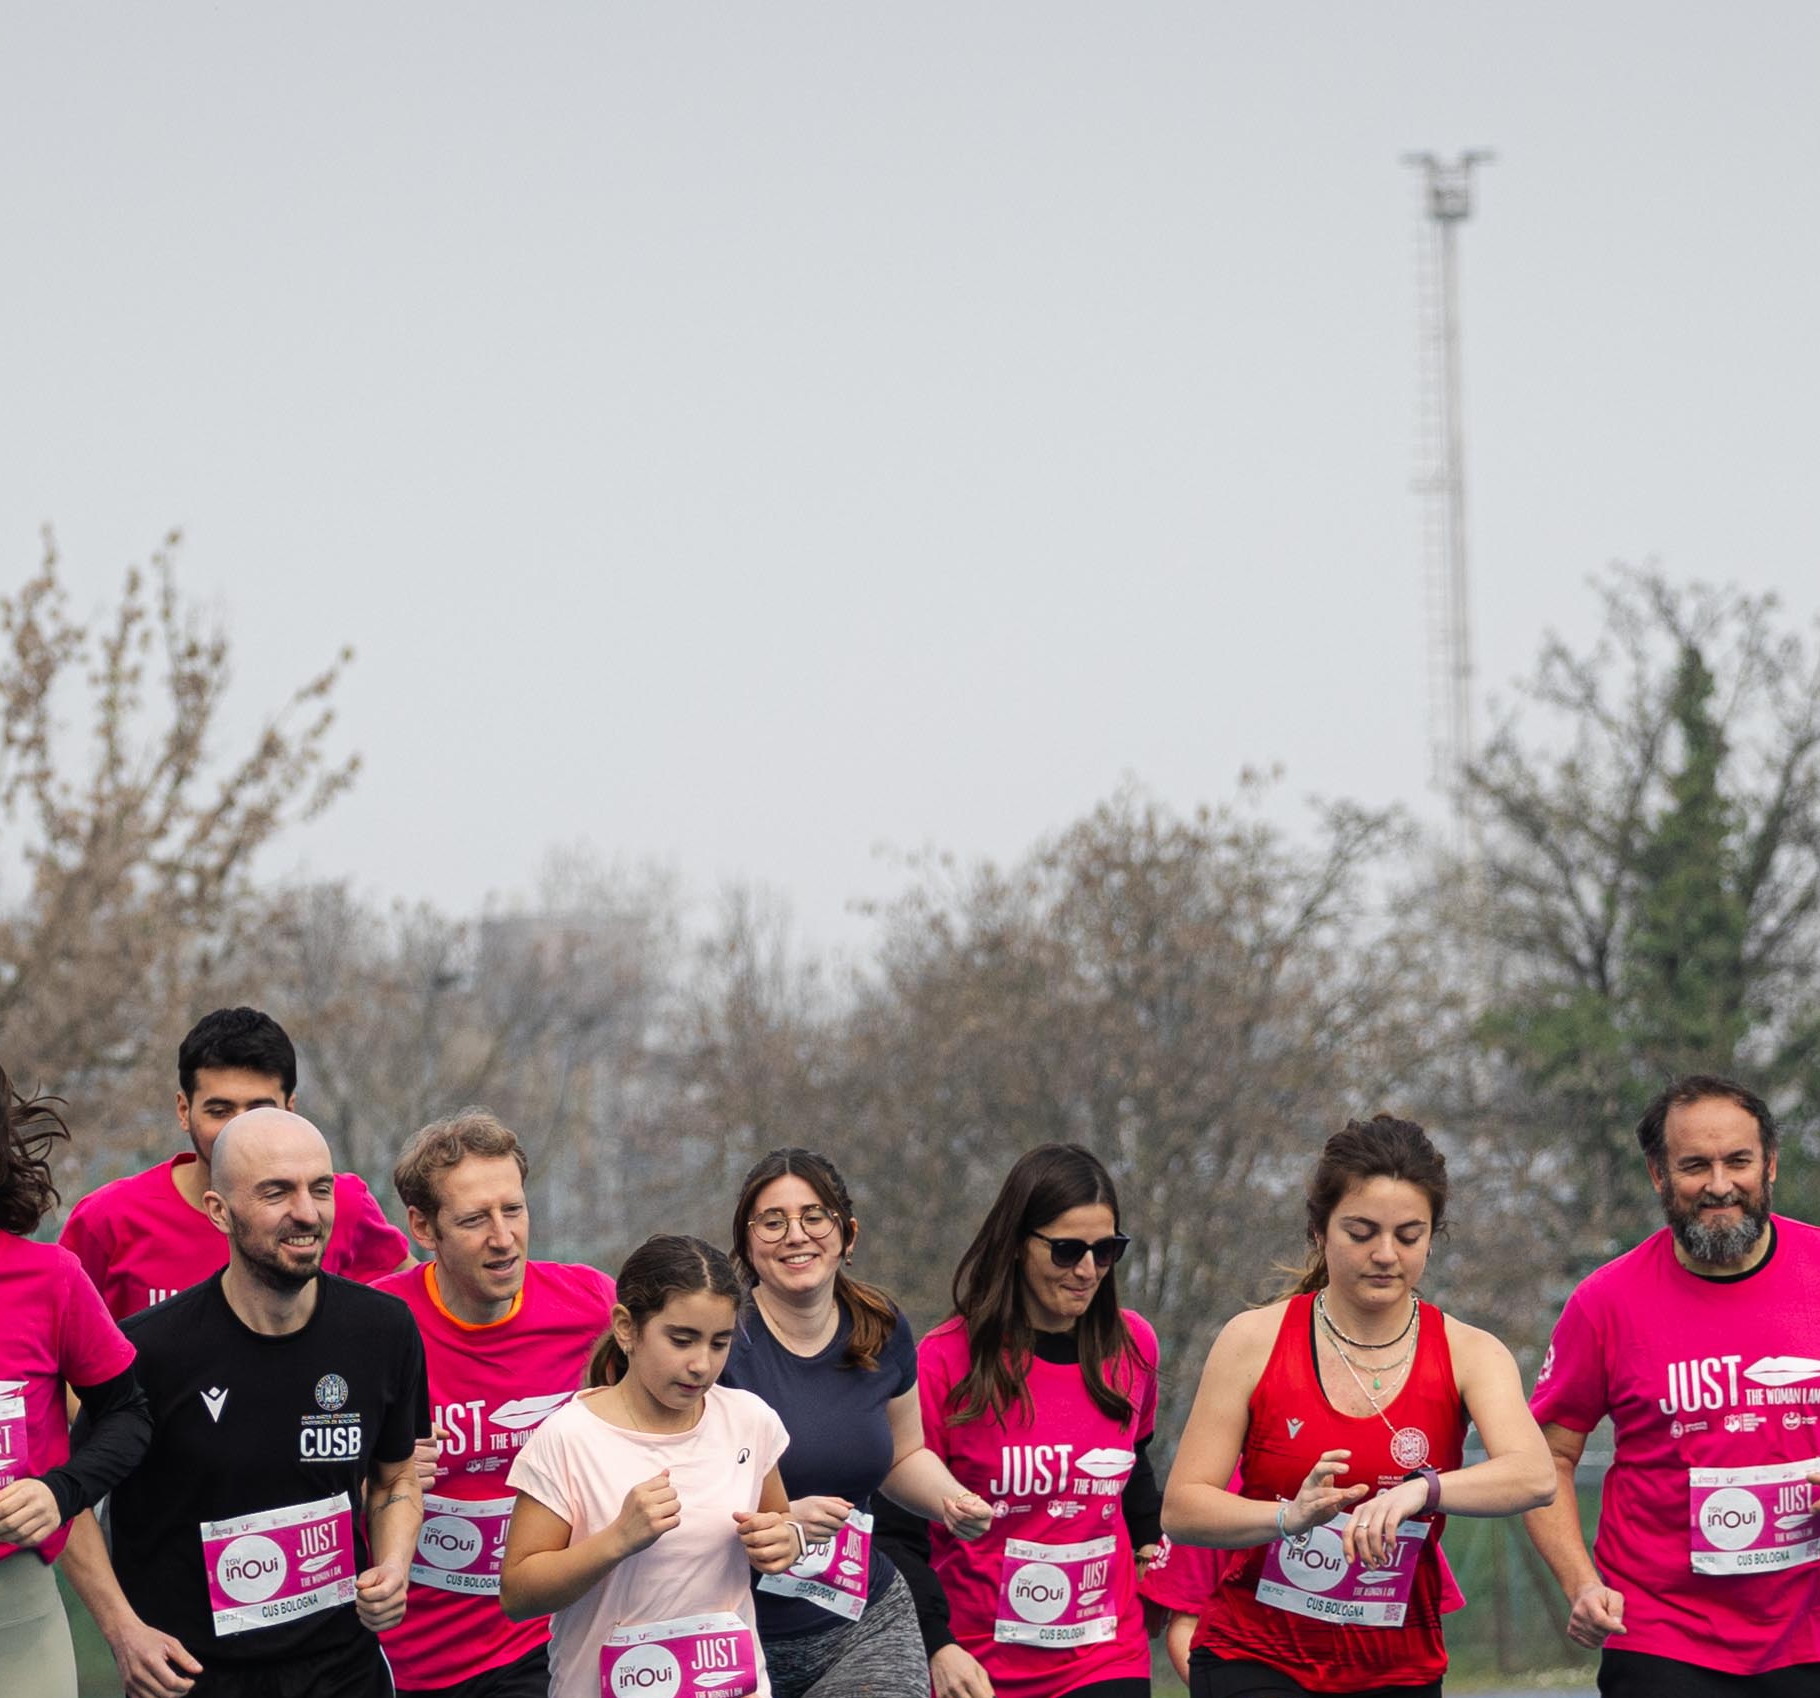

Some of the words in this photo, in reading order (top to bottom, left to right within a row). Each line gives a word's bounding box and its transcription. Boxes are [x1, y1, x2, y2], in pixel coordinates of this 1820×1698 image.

[1659, 1355, 1741, 1415] JUST
[1745, 1389, 1764, 1406] THE
[1766, 1388, 1802, 1405] WOMAN
[300, 1426, 361, 1457] CUSB
[490, 1433, 509, 1450] THE
[990, 1444, 1073, 1496] JUST
[1073, 1478, 1091, 1495] THE
[1774, 1483, 1812, 1514] JUST
[296, 1520, 338, 1558] JUST
[426, 1527, 442, 1535] TGV
[226, 1558, 241, 1566] TGV
[1737, 1555, 1752, 1566] CUS
[1755, 1550, 1790, 1565] BOLOGNA
[446, 1575, 463, 1586] CUS
[464, 1576, 501, 1587] BOLOGNA
[1079, 1560, 1109, 1592] JUST
[262, 1604, 279, 1617] CUS
[281, 1594, 318, 1614] BOLOGNA
[1306, 1597, 1324, 1611] CUS
[1325, 1601, 1364, 1617] BOLOGNA
[1039, 1627, 1055, 1640] CUS
[1057, 1627, 1085, 1640] BOLOGNA
[691, 1637, 738, 1670] JUST
